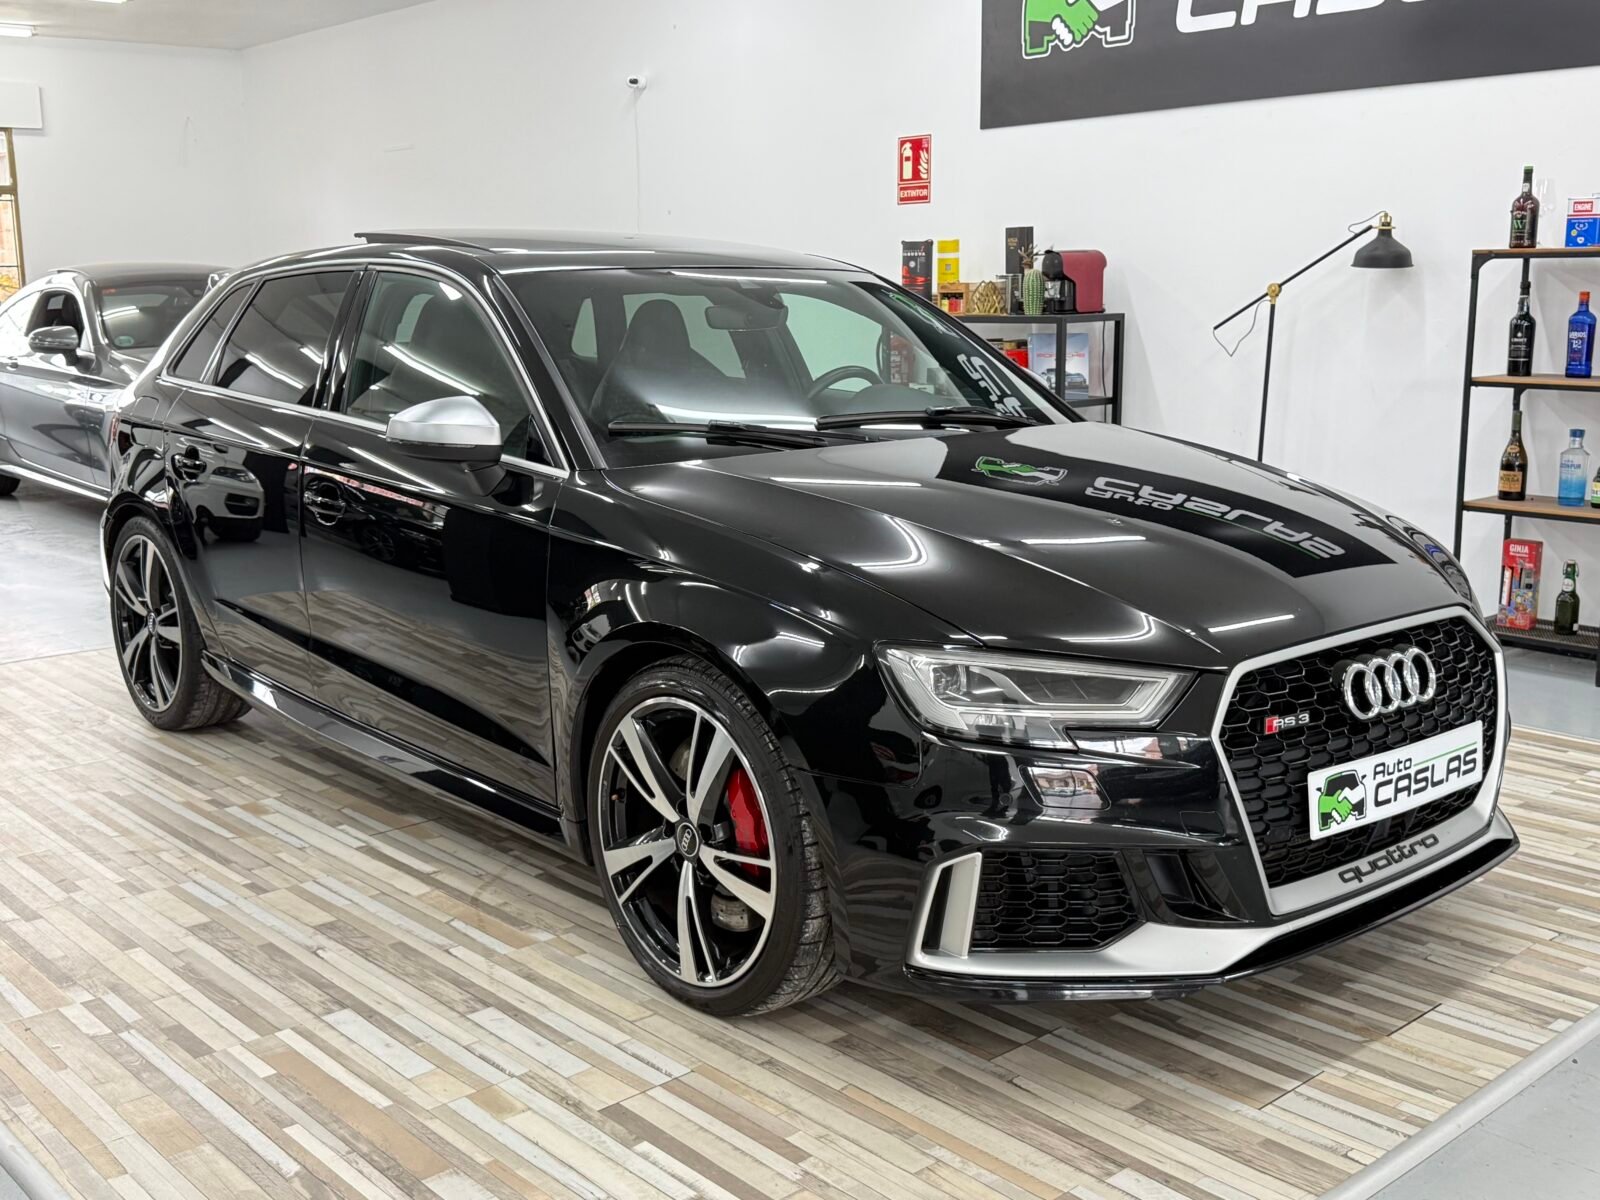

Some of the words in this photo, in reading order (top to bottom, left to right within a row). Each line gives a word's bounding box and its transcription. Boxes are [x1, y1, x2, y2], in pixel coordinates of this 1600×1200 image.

[900, 189, 928, 198] EXTINTOR
[1509, 543, 1529, 553] GINJA
[1373, 757, 1413, 780] Auto
[1373, 748, 1478, 808] CASLAS
[1338, 833, 1440, 883] quattro
